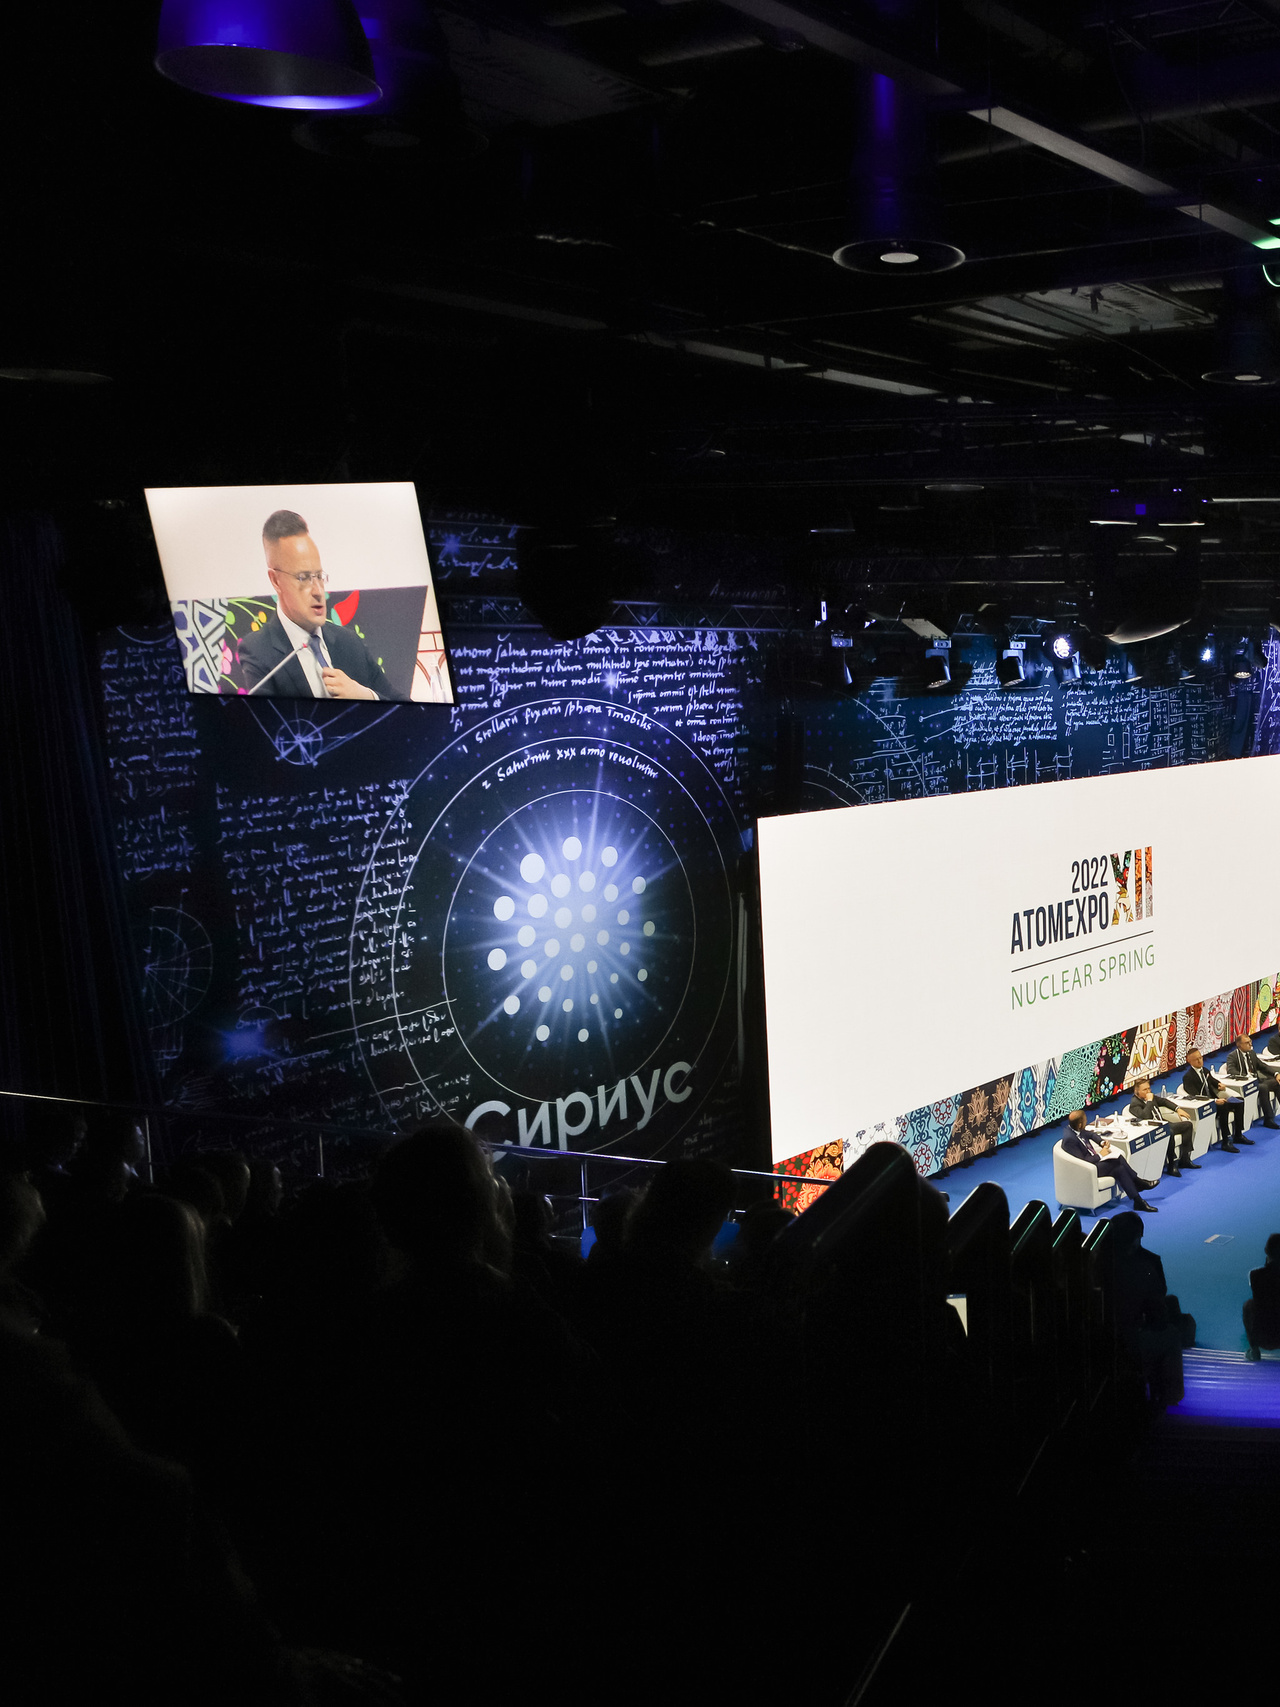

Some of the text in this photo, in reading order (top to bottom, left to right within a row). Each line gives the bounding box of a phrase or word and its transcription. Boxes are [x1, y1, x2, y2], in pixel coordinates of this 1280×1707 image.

[1072, 855, 1108, 893] 2022
[1110, 846, 1153, 926] XII
[1011, 892, 1109, 954] ATOMEXPO
[1011, 944, 1155, 1010] NUCLEAR SPRING
[464, 1061, 693, 1163] Сириус
